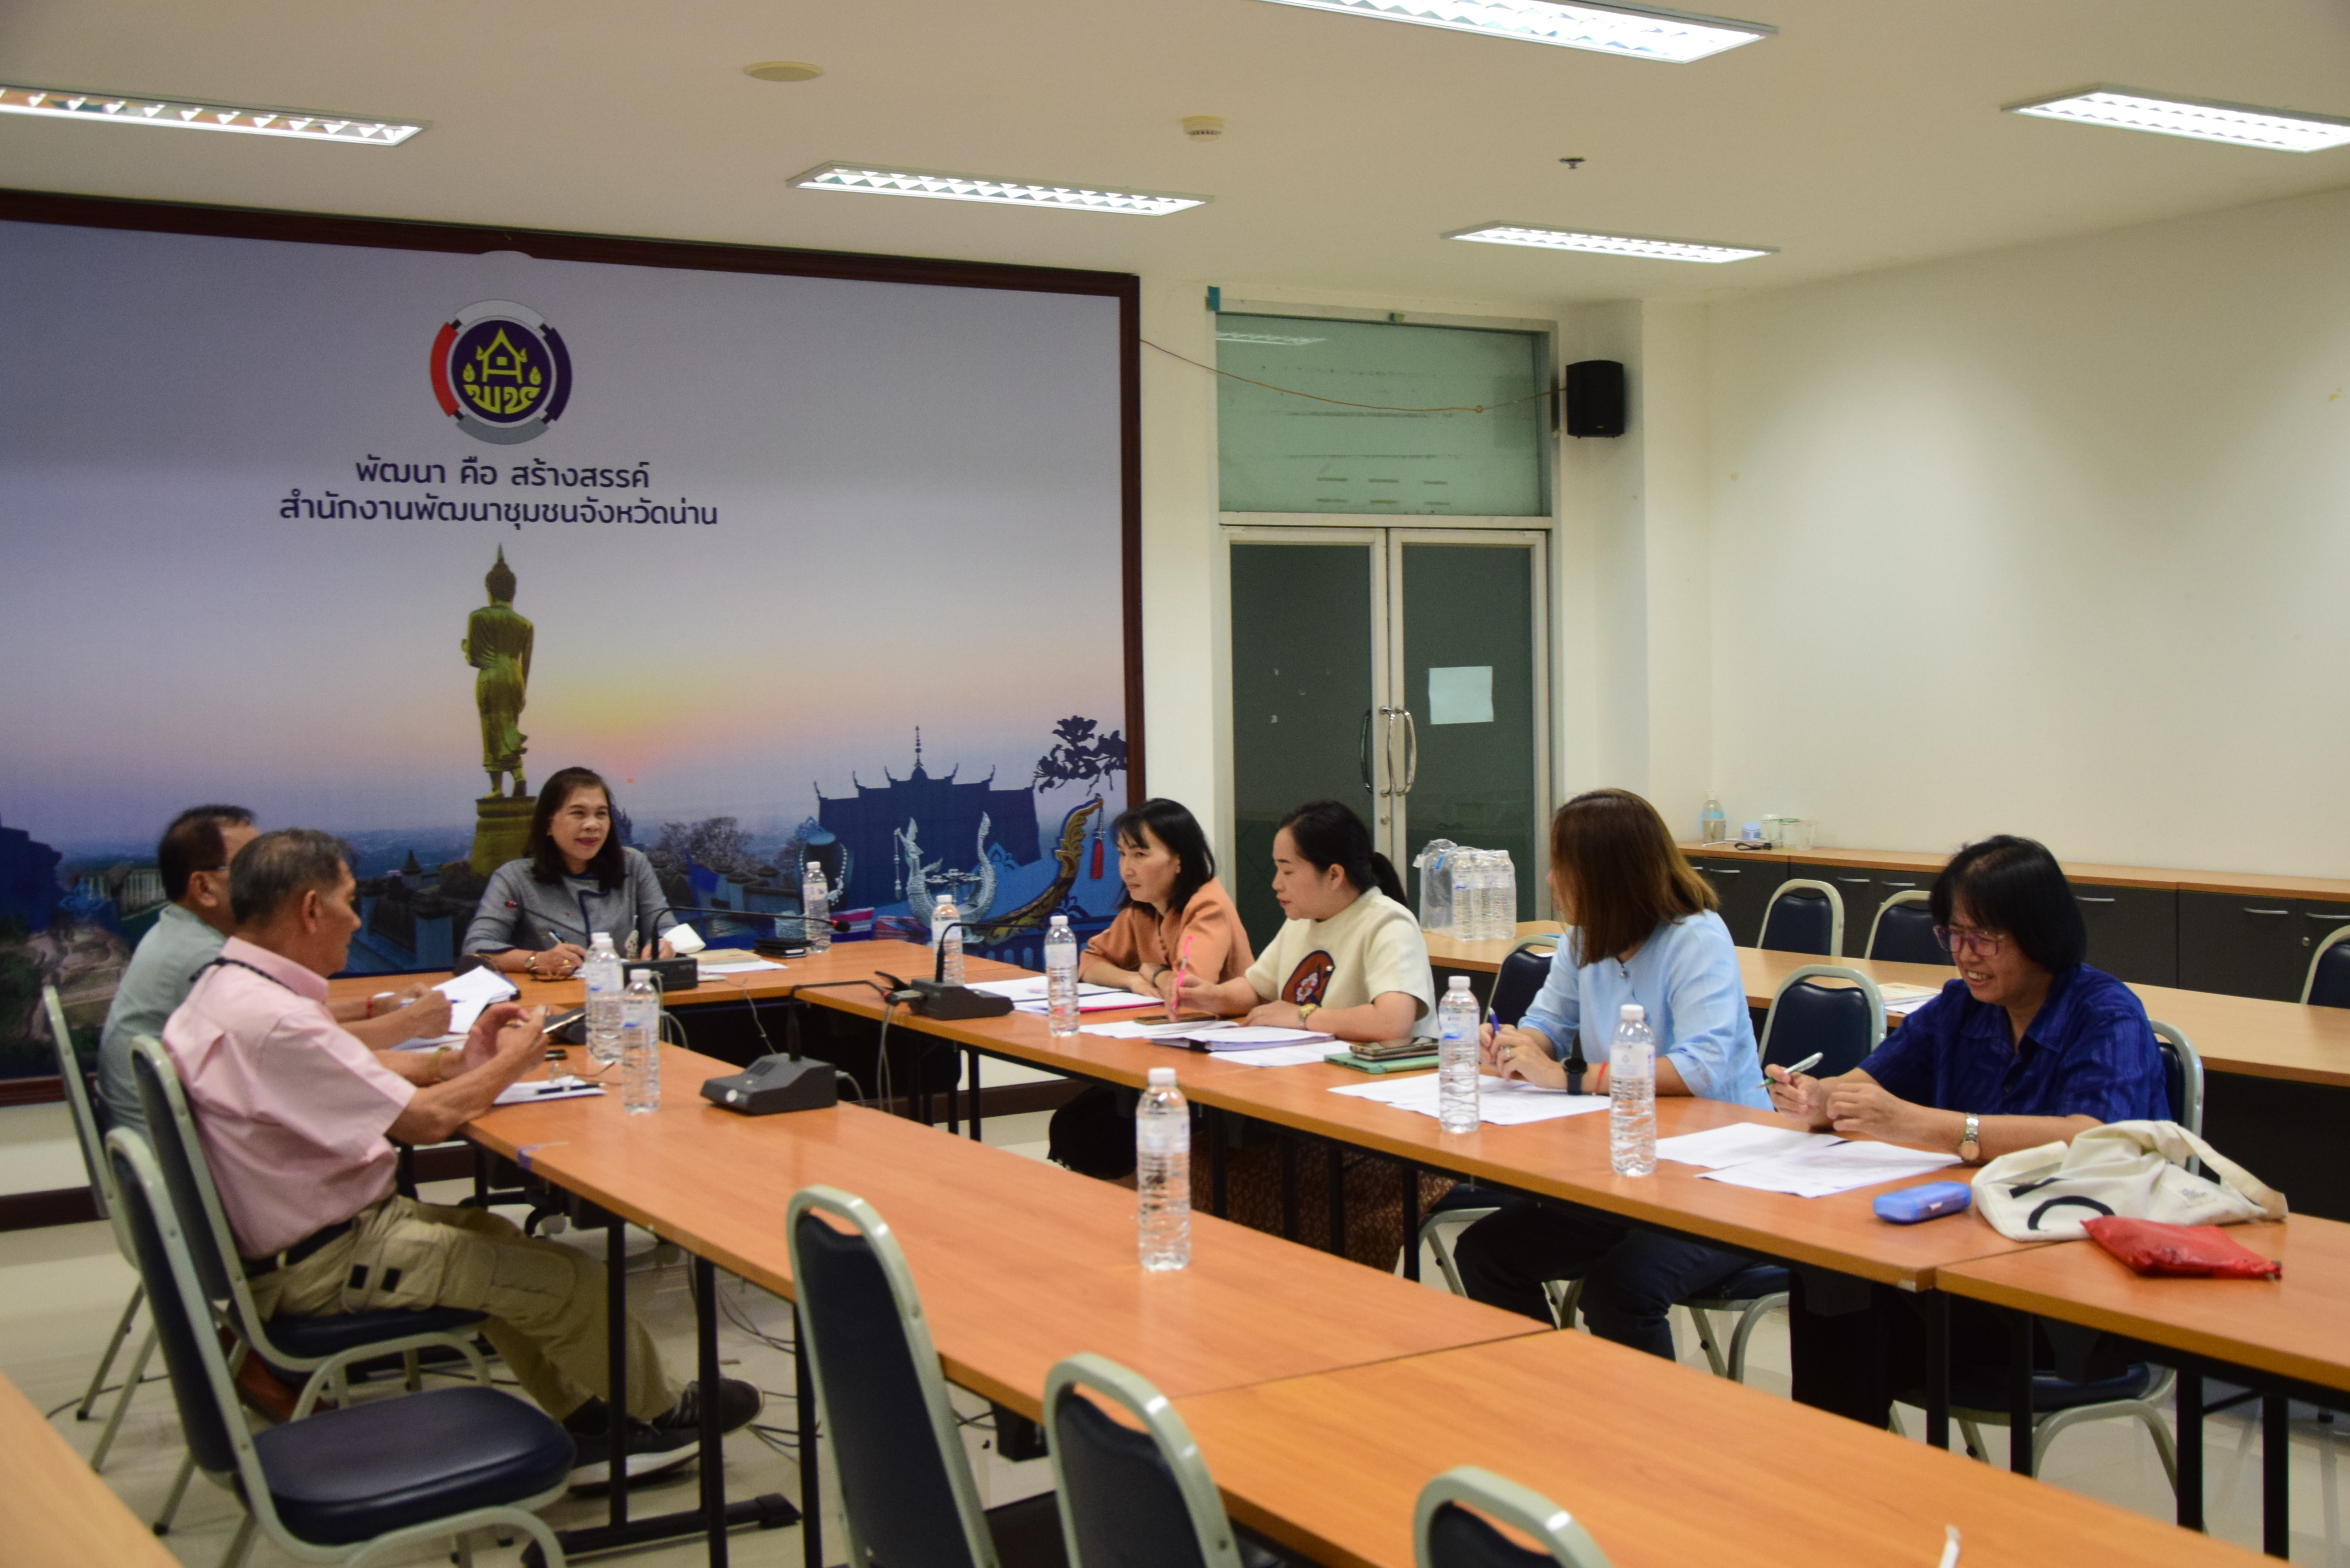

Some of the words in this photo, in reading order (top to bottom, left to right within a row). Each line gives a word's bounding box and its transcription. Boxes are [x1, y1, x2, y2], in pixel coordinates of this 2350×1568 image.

[355, 453, 446, 484] พัฒนา
[460, 455, 498, 486] คือ
[511, 457, 650, 488] สร้างสรรค์
[279, 488, 718, 531] สำนักงานพัฒนาชุมชนจังหวัดน่าน
